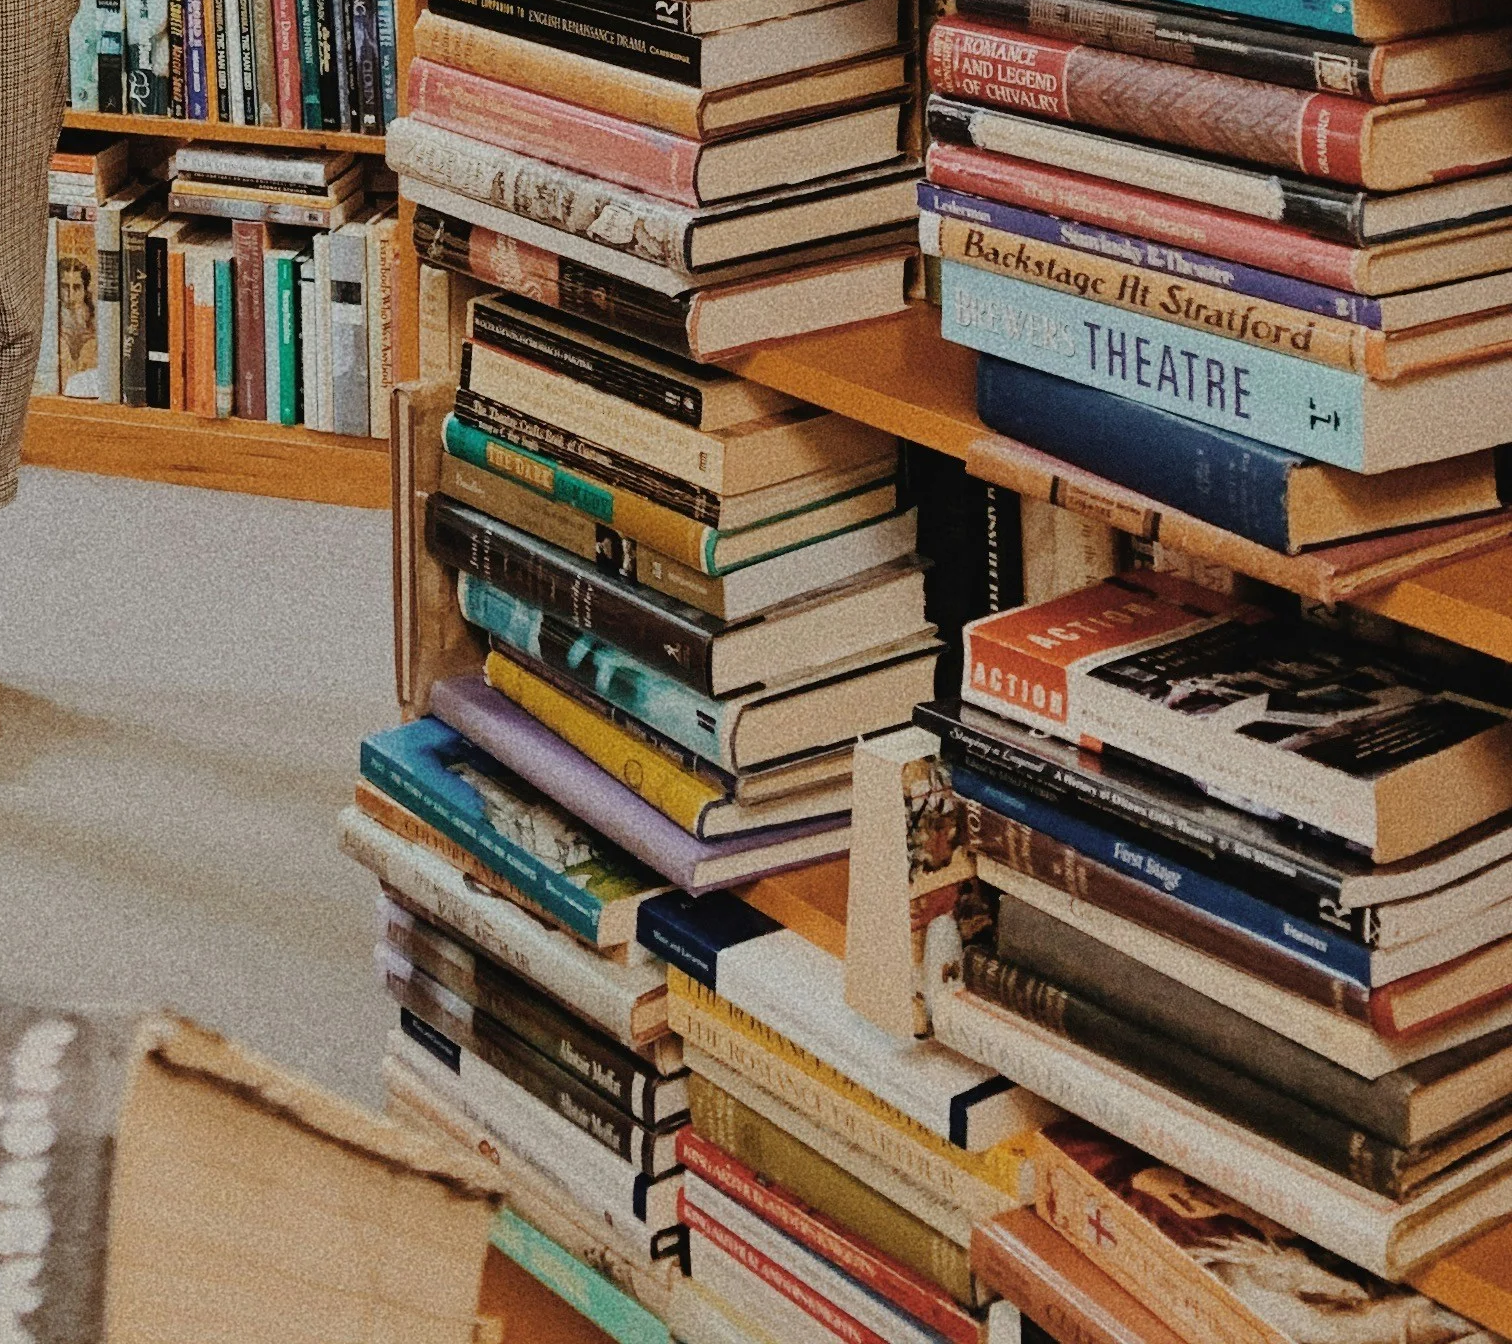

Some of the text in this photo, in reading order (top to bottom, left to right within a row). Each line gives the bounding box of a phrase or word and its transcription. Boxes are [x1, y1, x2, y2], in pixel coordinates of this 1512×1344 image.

[217, 33, 225, 49] THE
[241, 34, 251, 50] THE
[517, 7, 524, 18] TO
[529, 10, 561, 30] ENGLISH
[562, 17, 615, 45] RENAISSANCE
[616, 33, 646, 53] DRAMA
[217, 49, 226, 70] MAN
[242, 51, 251, 70] MAN
[963, 36, 1037, 66] ROMANCE
[962, 59, 1057, 93] AND LEGEND
[962, 80, 1058, 113] OF CHIVALRY
[964, 229, 1105, 295] Backstage
[1117, 273, 1150, 305] At
[1160, 284, 1315, 352] Stratford
[379, 239, 393, 389] Everybody Who Was Anybody
[1084, 322, 1251, 419] THEATRE
[1027, 601, 1159, 650] ACTION
[972, 663, 1063, 715] ACTION
[1112, 841, 1182, 892] First Stage
